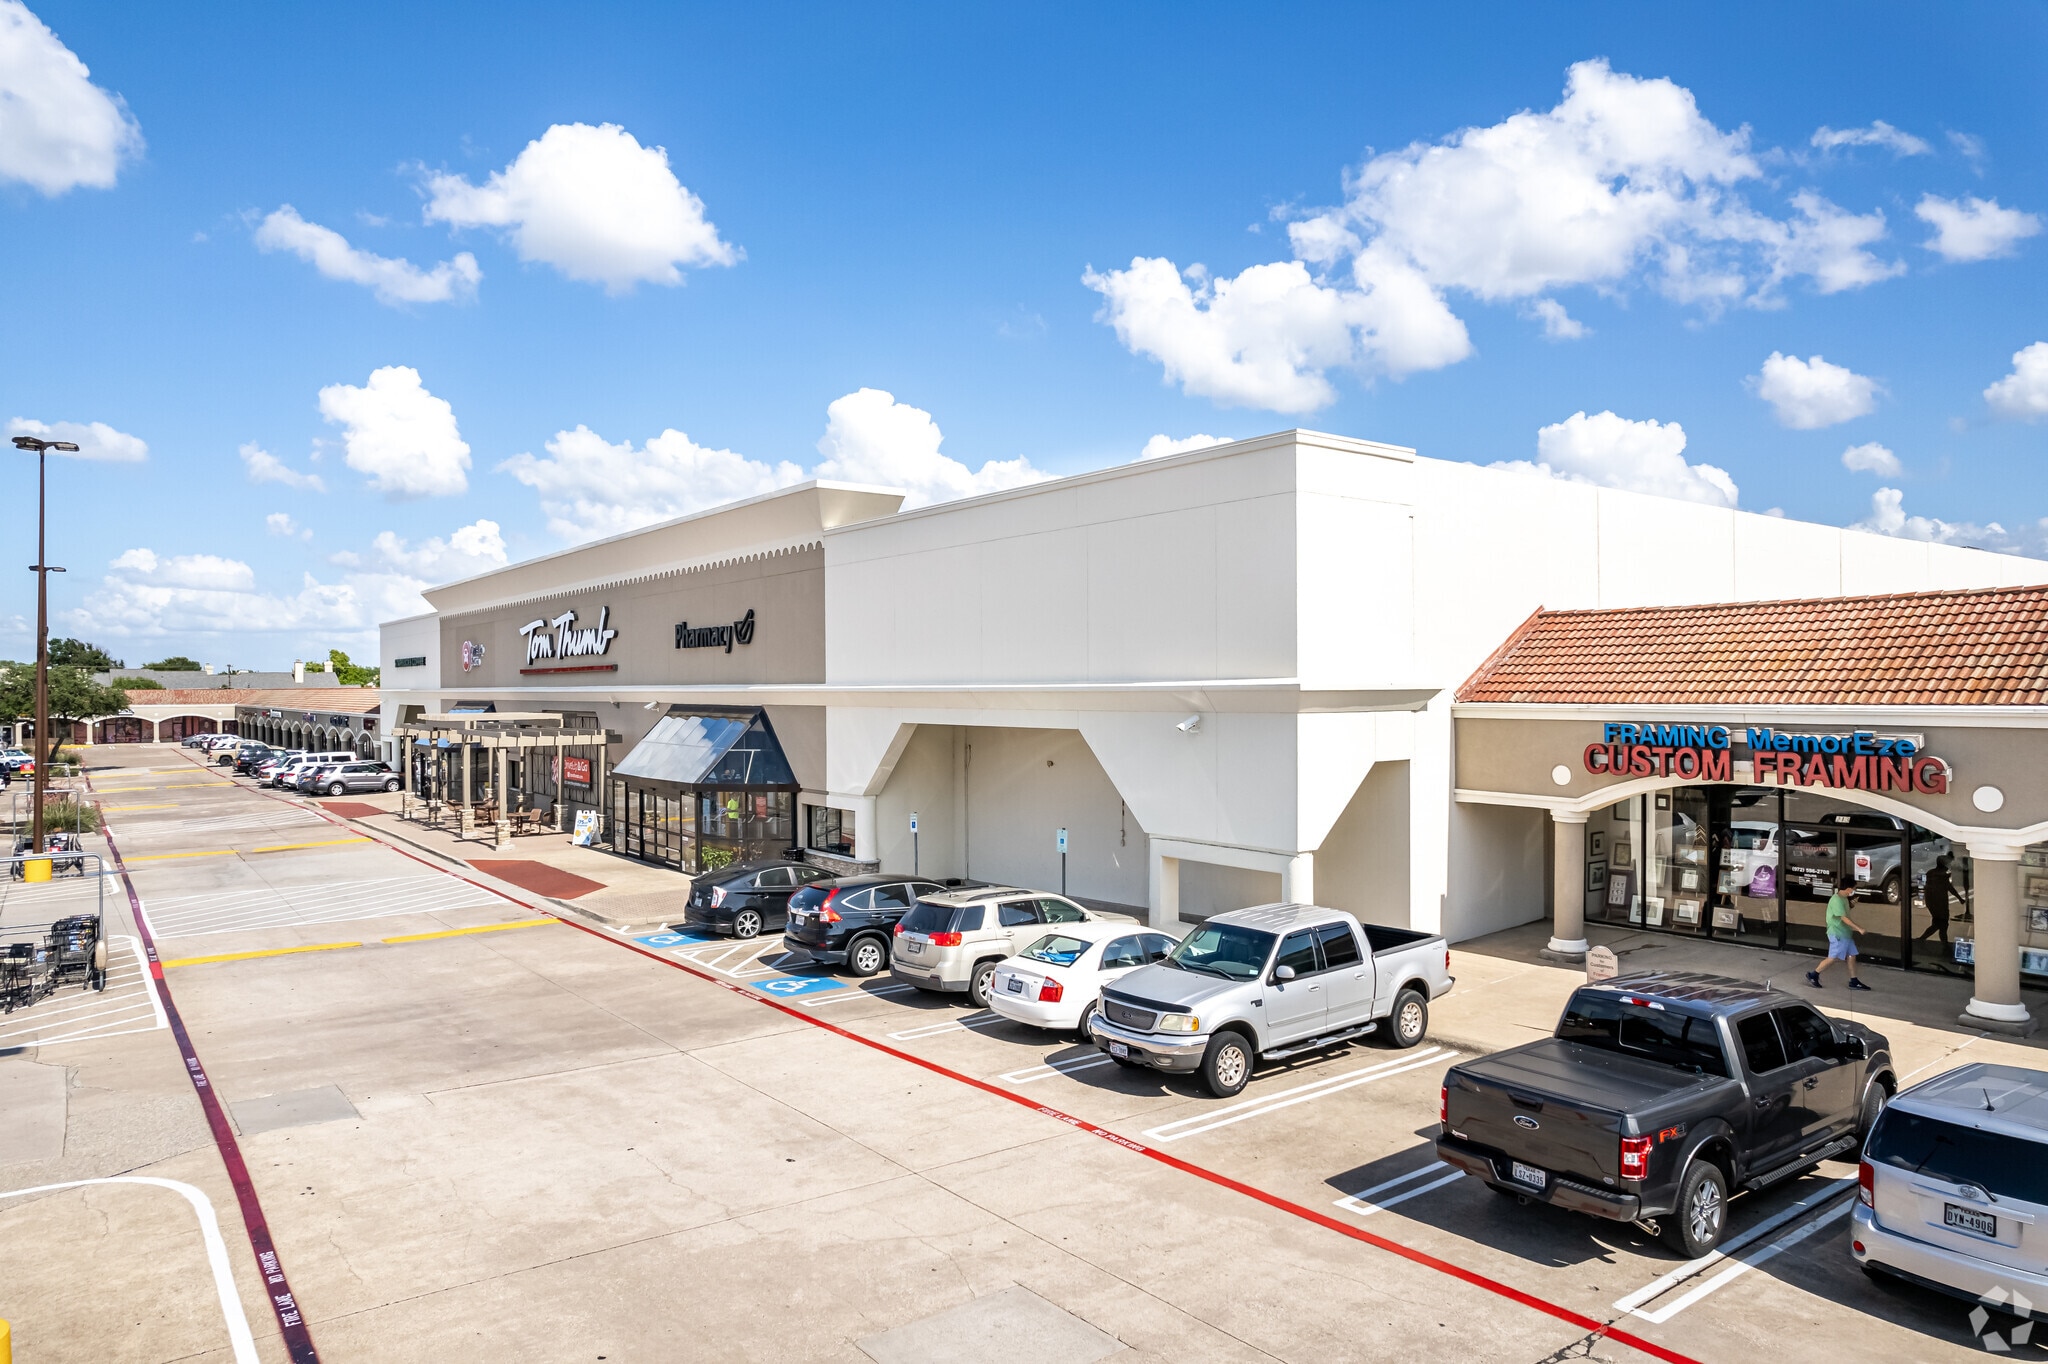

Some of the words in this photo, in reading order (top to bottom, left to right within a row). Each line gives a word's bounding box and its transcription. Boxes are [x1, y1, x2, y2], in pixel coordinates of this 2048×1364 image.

[520, 619, 555, 665] Tom
[552, 605, 618, 660] Thumb
[674, 621, 733, 653] Pharmacy
[1604, 722, 1731, 749] FRAMING
[1746, 727, 1920, 757] MemorEze
[1584, 743, 1734, 782] CUSTOM
[1753, 751, 1947, 795] FRAMING
[1038, 1106, 1057, 1118] FIRE
[1056, 1114, 1080, 1126] LANE
[1105, 1134, 1146, 1152] PARKING
[259, 1250, 281, 1275] PARKING
[268, 1273, 285, 1285] NO
[274, 1292, 296, 1311] LANE
[281, 1309, 302, 1328] FIRE
